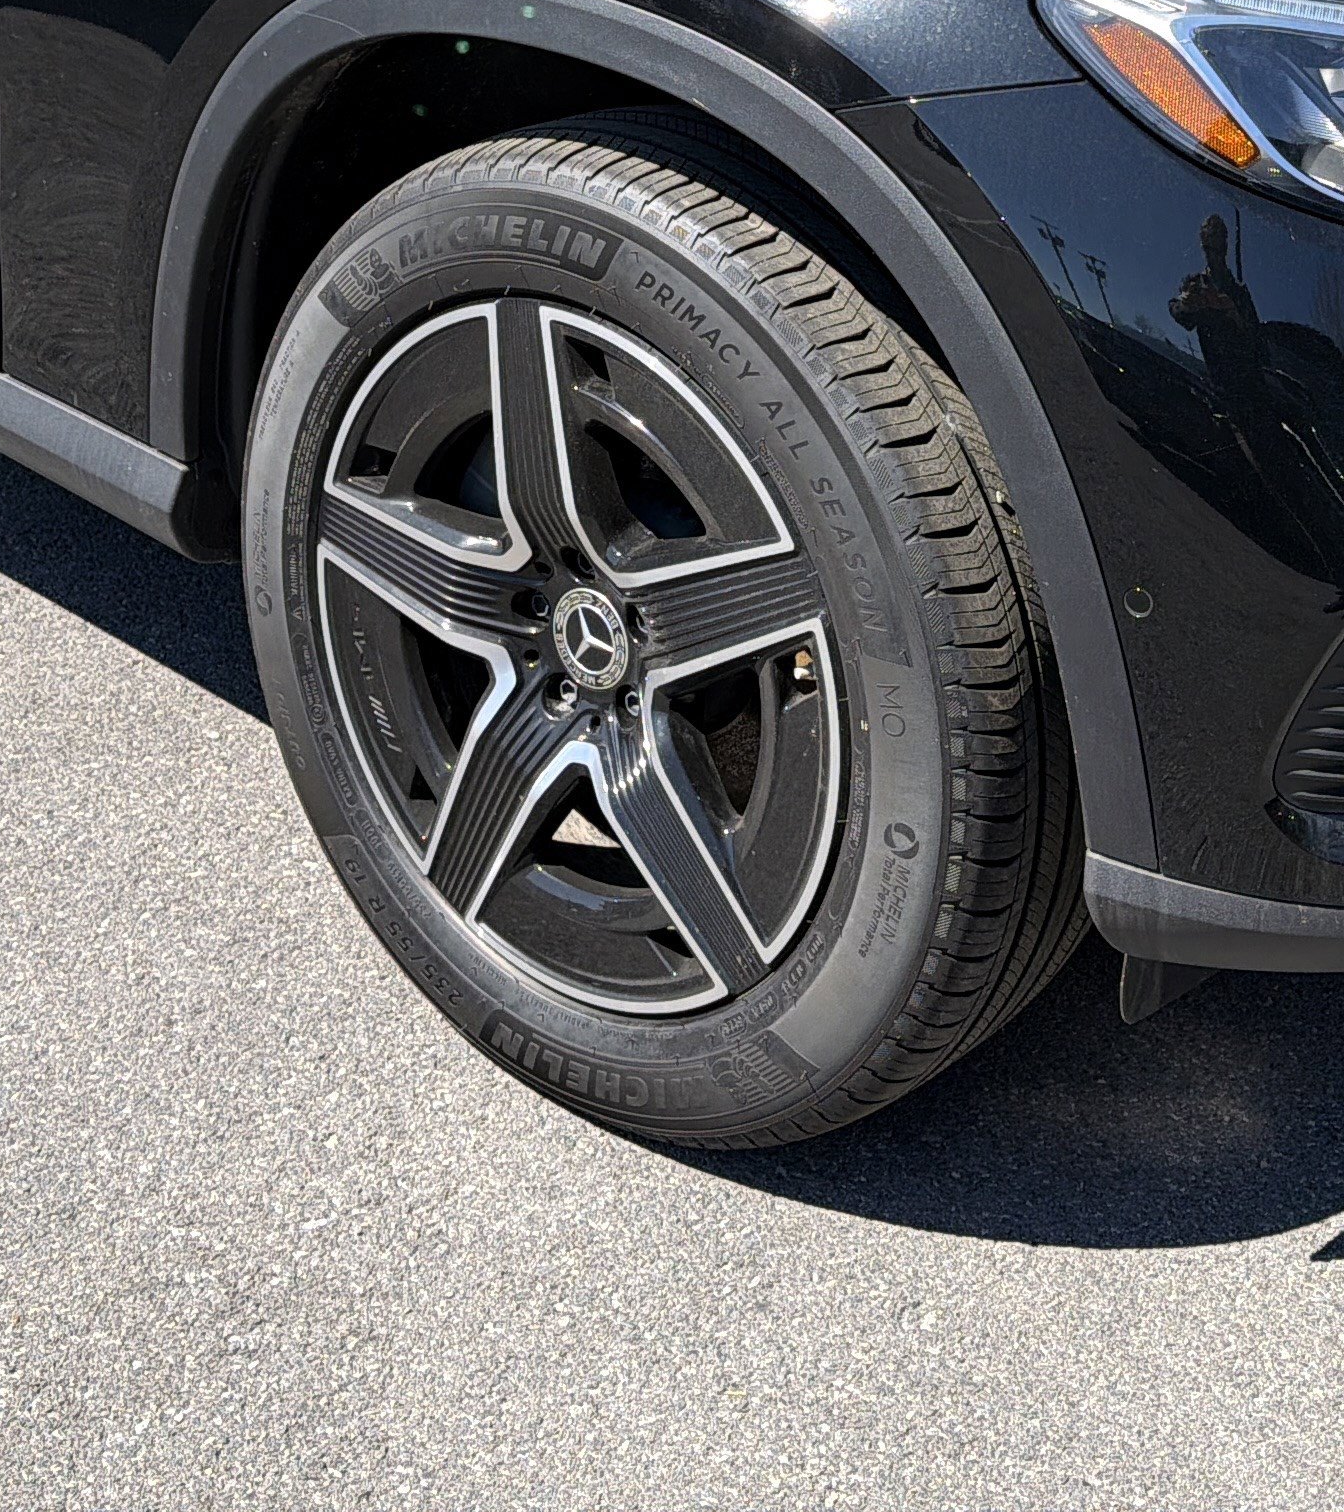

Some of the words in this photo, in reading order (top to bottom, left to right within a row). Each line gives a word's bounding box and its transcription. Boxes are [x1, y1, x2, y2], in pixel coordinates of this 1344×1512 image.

[399, 215, 606, 269] MICHELIN
[635, 271, 760, 381] PRIMACY
[759, 401, 811, 460] ALL
[809, 476, 889, 633] SEASON
[876, 683, 907, 737] MO
[344, 859, 367, 883] 19
[881, 854, 897, 884] Total
[368, 894, 386, 914] R
[857, 883, 889, 959] Performance
[879, 864, 911, 945] MICHELIN
[490, 1020, 706, 1110] MICHELIN
